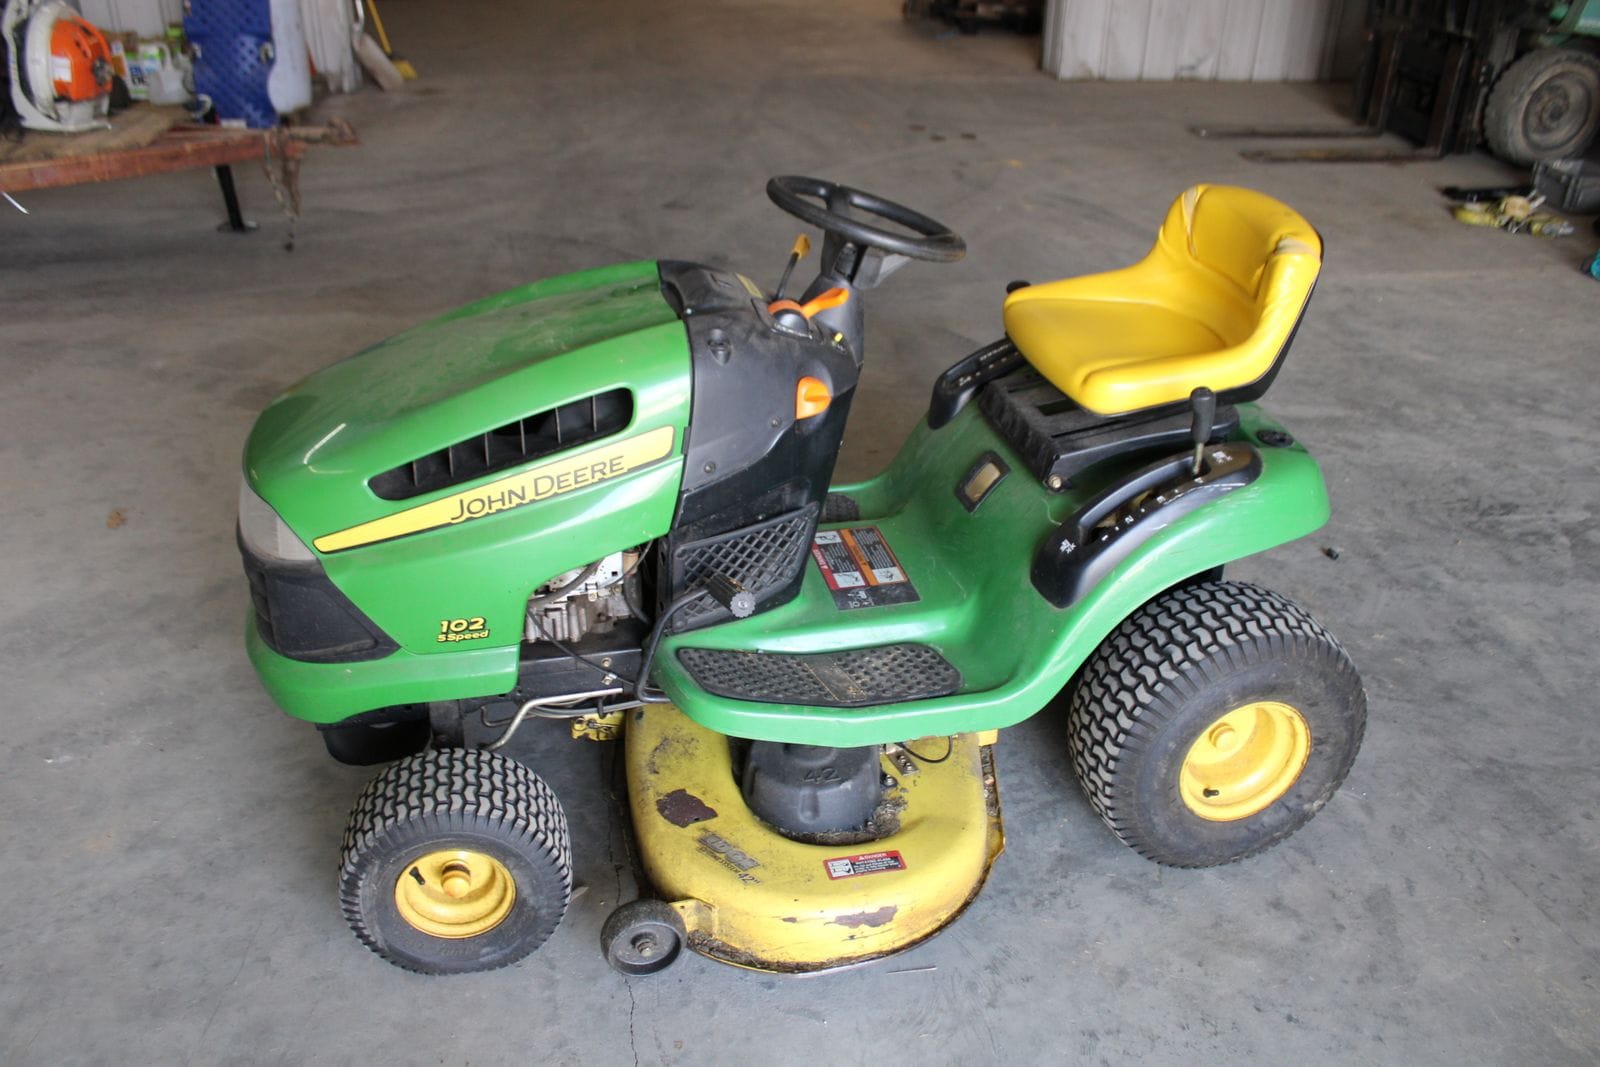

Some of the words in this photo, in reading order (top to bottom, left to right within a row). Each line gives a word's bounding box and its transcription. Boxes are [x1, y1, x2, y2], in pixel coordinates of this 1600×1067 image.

[450, 485, 527, 522] JOHN
[533, 455, 625, 498] DEERE
[440, 616, 486, 634] 102
[803, 767, 841, 784] 42
